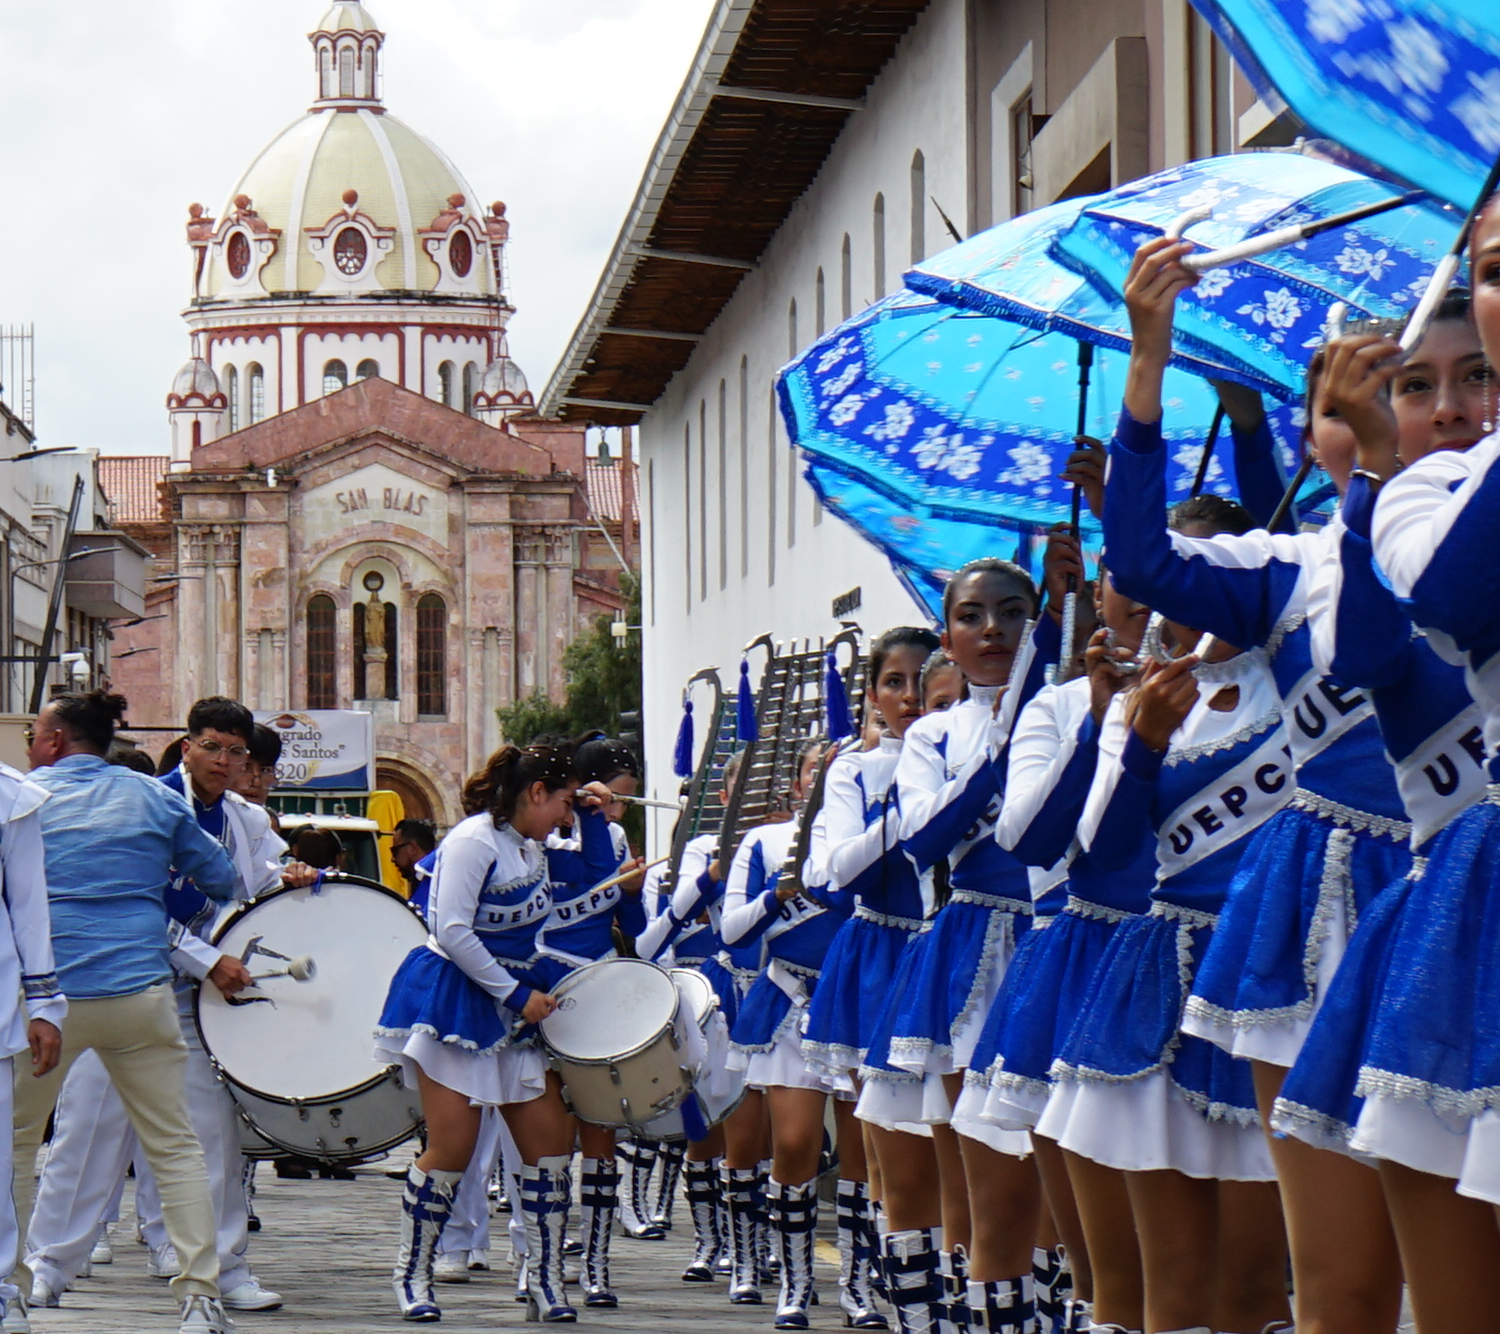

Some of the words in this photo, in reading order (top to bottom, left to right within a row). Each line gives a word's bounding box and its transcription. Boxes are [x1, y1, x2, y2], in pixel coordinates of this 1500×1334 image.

[336, 487, 369, 514] SAN
[383, 487, 429, 516] BLAS
[1168, 744, 1292, 855] UEPC
